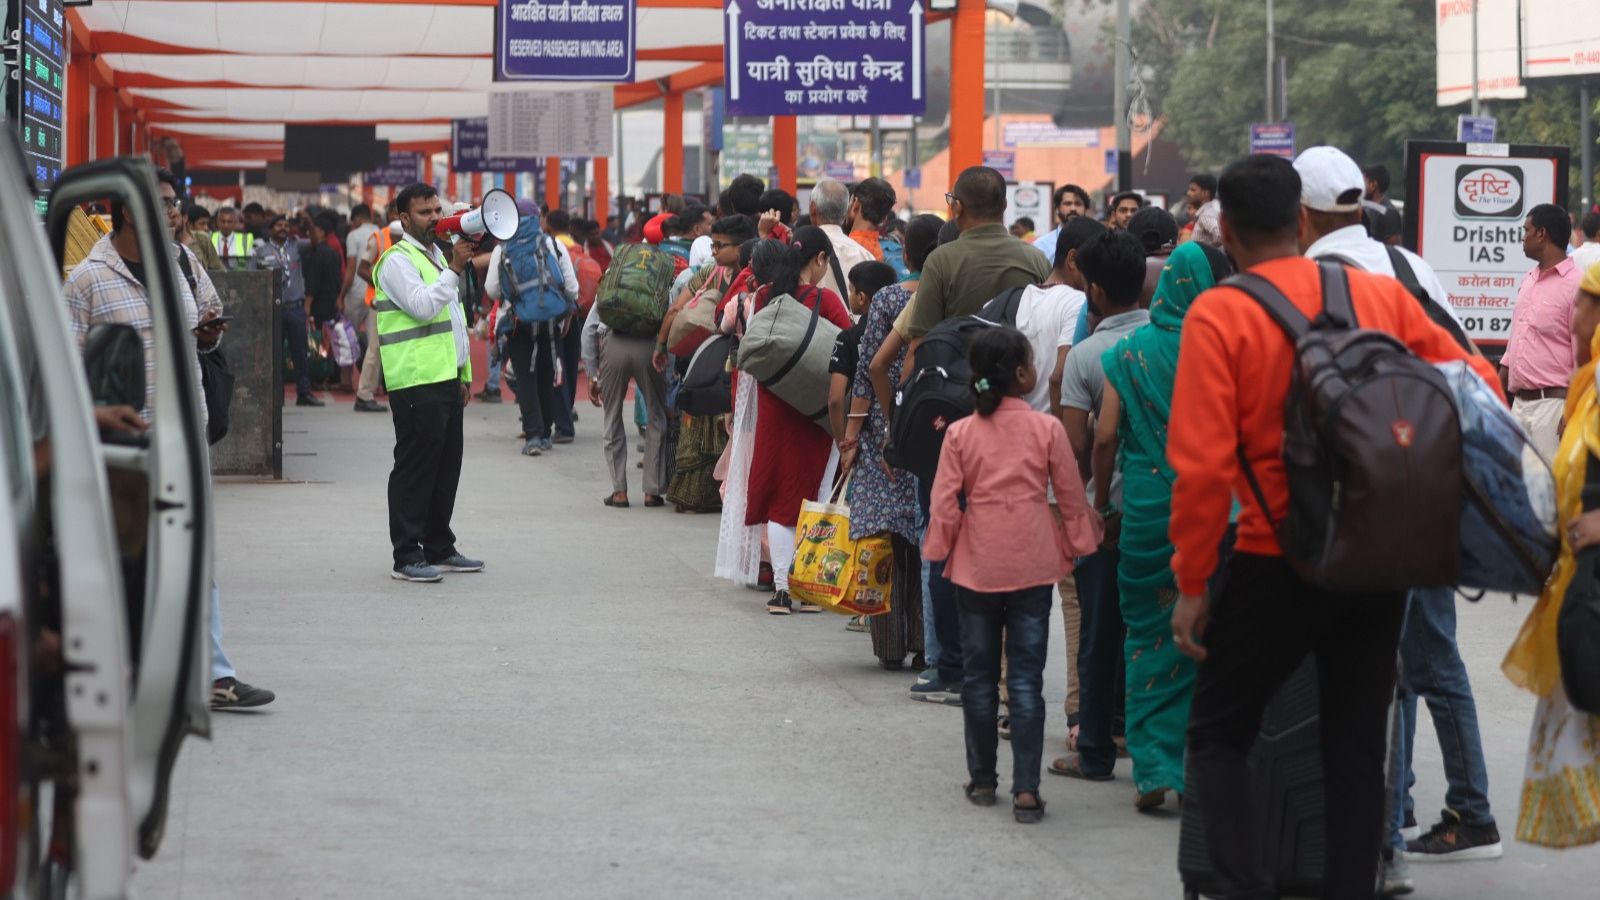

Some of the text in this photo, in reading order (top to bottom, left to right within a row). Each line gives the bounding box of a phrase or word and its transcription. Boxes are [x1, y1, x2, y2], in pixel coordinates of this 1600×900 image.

[511, 0, 624, 23] आरक्षित यात्री प्रतीक्षा स्थल
[744, 20, 906, 41] टिकट तथा स्टेशन प्रवेश के लिए
[510, 39, 624, 57] RESERVED PASSENGER WAITING AREA
[746, 54, 904, 86] यात्री सुविधा केन्द्र
[784, 85, 868, 104] का प्रयोग करें
[1463, 173, 1511, 202] दृष्टि
[1453, 225, 1522, 243] Drishti
[1469, 246, 1505, 263] IAS
[1458, 273, 1515, 287] करोल बाग
